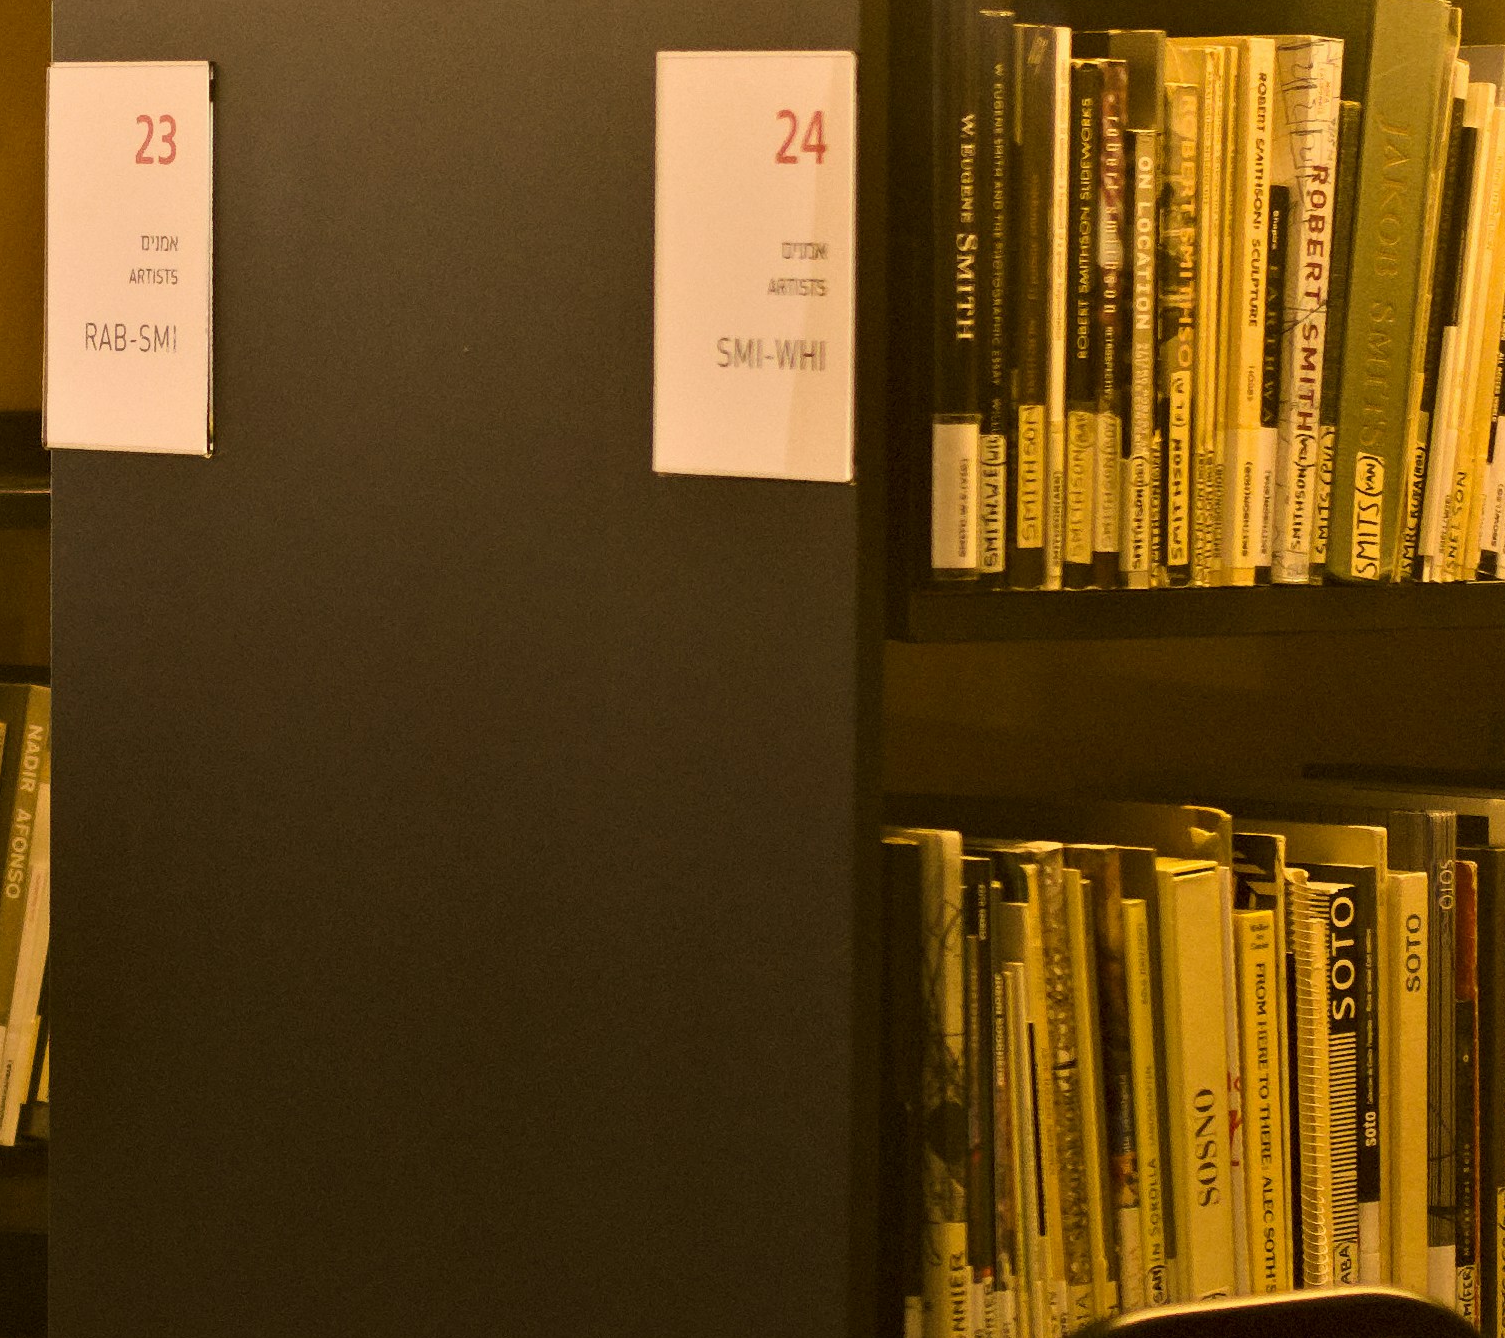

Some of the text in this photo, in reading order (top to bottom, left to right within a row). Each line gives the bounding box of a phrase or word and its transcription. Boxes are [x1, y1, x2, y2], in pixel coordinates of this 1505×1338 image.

[1256, 72, 1268, 132] ROBERT
[135, 114, 177, 165] 23
[775, 109, 827, 164] 24
[1137, 157, 1152, 189] ON
[142, 235, 179, 252] אמנים
[955, 144, 978, 341] EUGENE SMITH
[1077, 207, 1091, 293] SMITHSON
[1136, 202, 1152, 330] LOCATION
[129, 269, 179, 285] ARTISTS
[767, 278, 827, 296] ARTISTS
[1177, 231, 1196, 367] SMITHSO
[1247, 239, 1261, 327] SCULPTURE
[1295, 165, 1331, 432] ROBERT SMITH
[1358, 123, 1411, 447] JAKOB SMITS
[85, 322, 177, 353] RAB-SMI
[716, 337, 827, 371] SMI-WHI
[1076, 301, 1089, 360] ROBERT
[1019, 406, 1039, 541] SMITHSON
[5, 724, 44, 899] NADIR AFONSO
[1331, 896, 1356, 1020] SOTO
[1405, 913, 1422, 993] SOTO
[1254, 962, 1268, 1016] FROM
[1255, 1020, 1269, 1069] HERE
[1257, 1073, 1268, 1099] TO
[1193, 1089, 1221, 1208] SOSNO
[1261, 1175, 1274, 1222] ALEC
